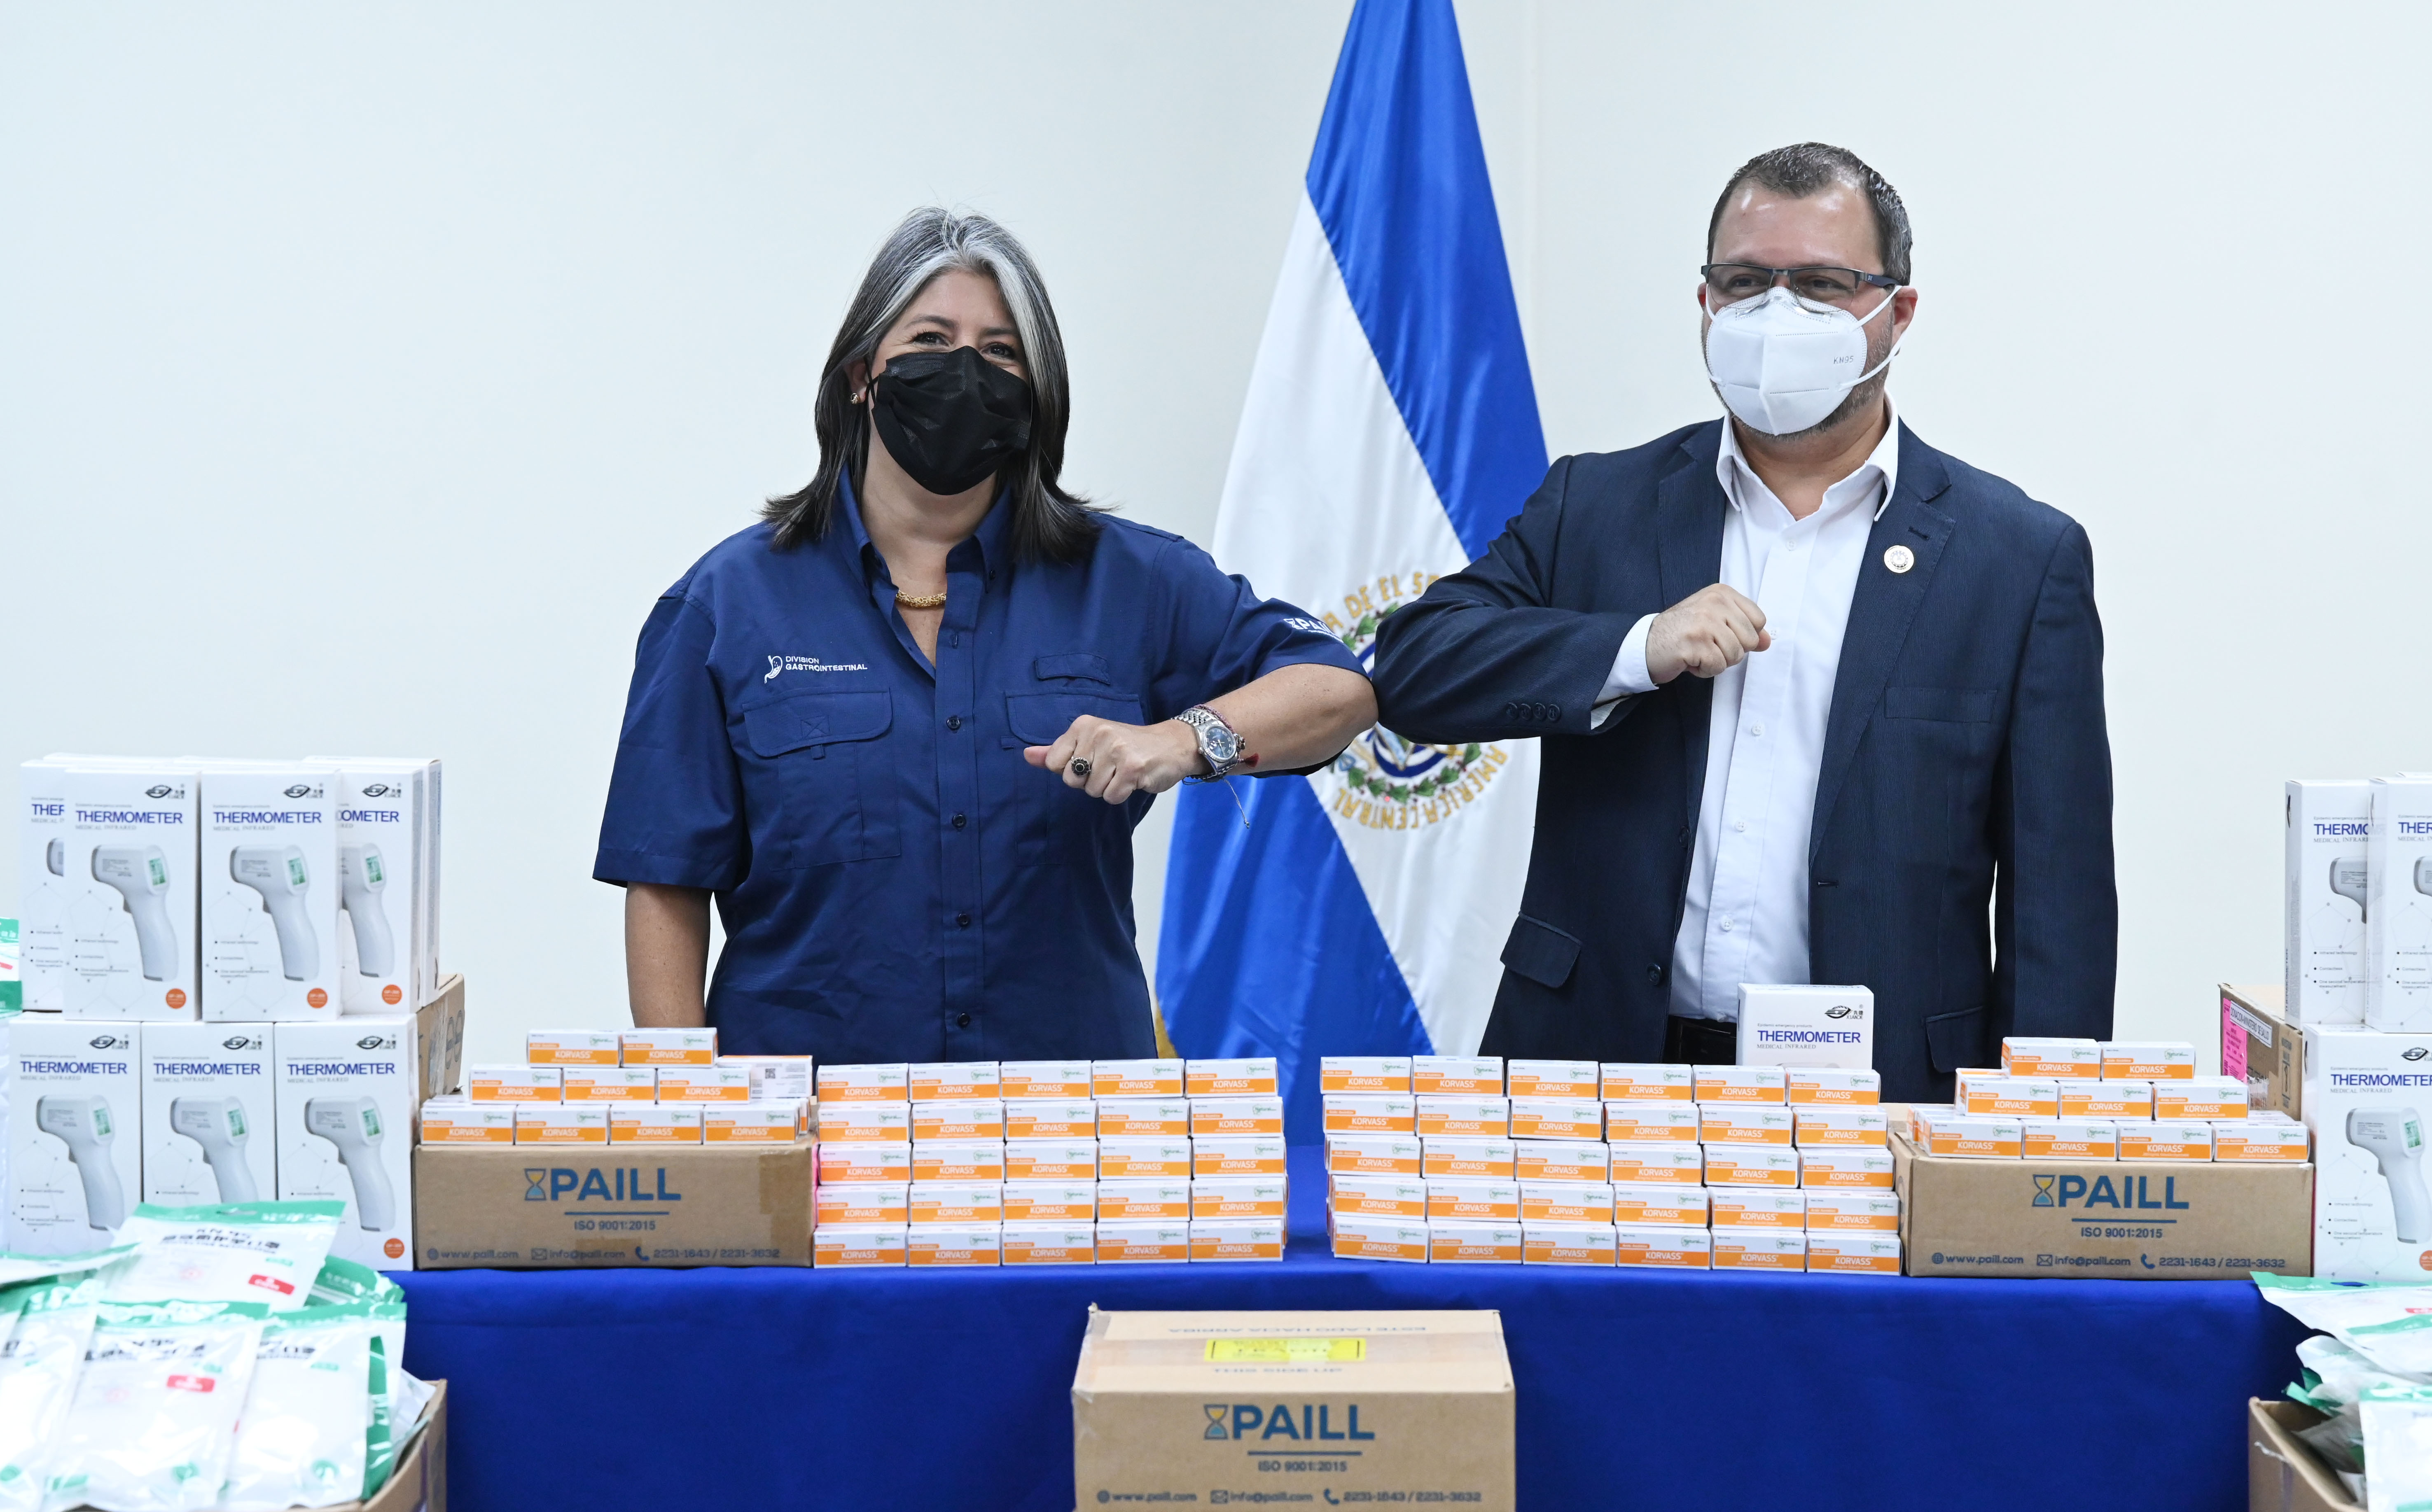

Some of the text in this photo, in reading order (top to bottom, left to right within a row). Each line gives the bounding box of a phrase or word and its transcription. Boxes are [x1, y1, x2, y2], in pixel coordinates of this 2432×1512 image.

[1833, 355, 1854, 364] KN95
[1345, 586, 1374, 618] DE
[1379, 575, 1403, 601] EL
[1334, 745, 1507, 829] AMERICA CENTRAL
[76, 810, 183, 824] THERMOMETER
[213, 812, 322, 823] THERMOMETER
[1757, 1030, 1861, 1043] THERMOMETER
[555, 1050, 590, 1059] KORVASS
[649, 1050, 684, 1059] KORVASS
[20, 1061, 127, 1073] THERMOMETER
[153, 1063, 260, 1075] THERMOMETER
[287, 1063, 395, 1075] THERMOMETER
[2129, 1065, 2165, 1073] KORVASS
[1118, 1080, 1154, 1089] KORVASS
[1212, 1080, 1248, 1088] KORVASS
[1348, 1077, 1383, 1085] KORVASS
[1439, 1080, 1475, 1088] KORVASS
[2331, 1074, 2432, 1086] THERMOMETE
[498, 1087, 533, 1095] KORVASS
[591, 1087, 626, 1095] KORVASS
[685, 1087, 720, 1095] KORVASS
[844, 1087, 879, 1096] KORVASS
[937, 1085, 972, 1094] KORVASS
[1027, 1084, 1062, 1092] KORVASS
[1629, 1086, 1665, 1094] KORVASS
[1722, 1087, 1757, 1096] KORVASS
[2184, 1104, 2219, 1113] KORVASS
[1218, 1120, 1254, 1128] KORVASS
[1351, 1117, 1387, 1125] KORVASS
[1444, 1121, 1480, 1129] KORVASS
[939, 1125, 975, 1133] KORVASS
[1033, 1123, 1068, 1132] KORVASS
[1125, 1122, 1160, 1130] KORVASS
[1538, 1122, 1574, 1131] KORVASS
[449, 1128, 484, 1136] KORVASS
[542, 1128, 577, 1136] KORVASS
[636, 1127, 672, 1136] KORVASS
[731, 1127, 767, 1136] KORVASS
[844, 1128, 880, 1136] KORVASS
[2146, 1144, 2183, 1153] KORVASS
[2243, 1145, 2280, 1154] KORVASS
[1032, 1164, 1067, 1173] KORVASS
[1126, 1162, 1162, 1171] KORVASS
[1220, 1160, 1256, 1169] KORVASS
[846, 1167, 882, 1176] KORVASS
[939, 1166, 974, 1174] KORVASS
[1733, 1170, 1769, 1178] KORVASS
[1829, 1173, 1865, 1181] KORVASS
[551, 1168, 681, 1200] PAILL
[2059, 1175, 2189, 1209] PAILL
[1030, 1206, 1065, 1214] KORVASS
[1125, 1204, 1160, 1212] KORVASS
[1219, 1202, 1255, 1211] KORVASS
[844, 1209, 879, 1217] KORVASS
[937, 1208, 972, 1216] KORVASS
[1834, 1216, 1870, 1224] KORVASS
[575, 1220, 656, 1230] ISO 9001:2015
[2081, 1227, 2163, 1239] ISO 9001:2015
[1030, 1248, 1065, 1257] KORVASS
[1124, 1246, 1159, 1254] KORVASS
[1217, 1244, 1252, 1253] KORVASS
[1458, 1246, 1493, 1255] KORVASS
[841, 1251, 876, 1259] KORVASS
[935, 1251, 970, 1259] KORVASS
[1740, 1253, 1777, 1262] KORVASS
[1946, 1254, 2024, 1265] www.paill.com
[2055, 1254, 2131, 1267] info@paill.com
[2159, 1257, 2216, 1267] 2231-1643
[2225, 1257, 2285, 1267] 2231-3632
[1233, 1405, 1374, 1440] PAILL
[1258, 1461, 1347, 1472] ISO 9001:2015
